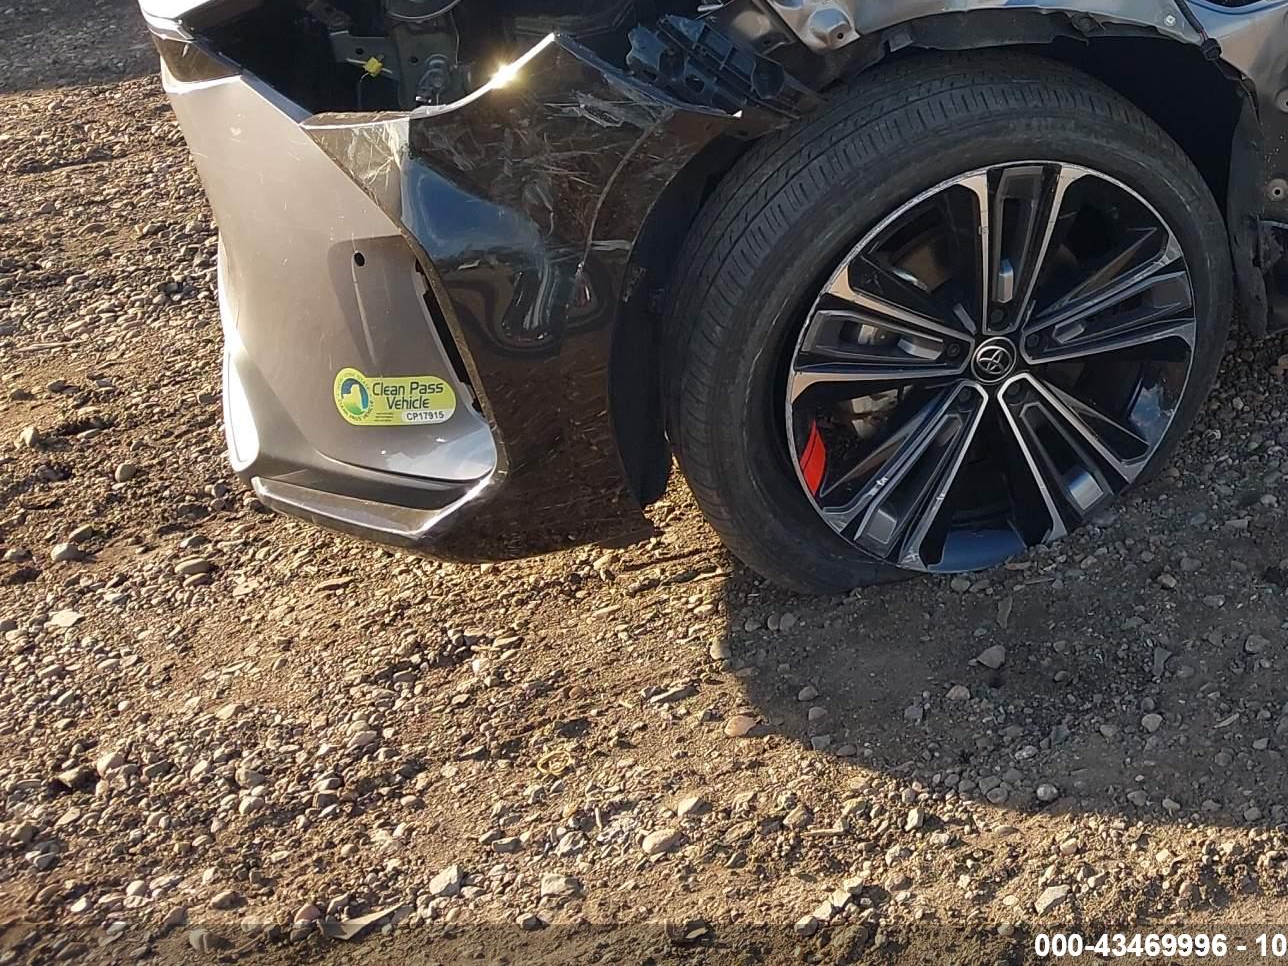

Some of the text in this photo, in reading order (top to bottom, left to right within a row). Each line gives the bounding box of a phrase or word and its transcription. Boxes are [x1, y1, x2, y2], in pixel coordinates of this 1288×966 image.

[372, 381, 444, 396] Clean Pass
[386, 396, 430, 410] Vehicle
[406, 410, 445, 422] CP17915
